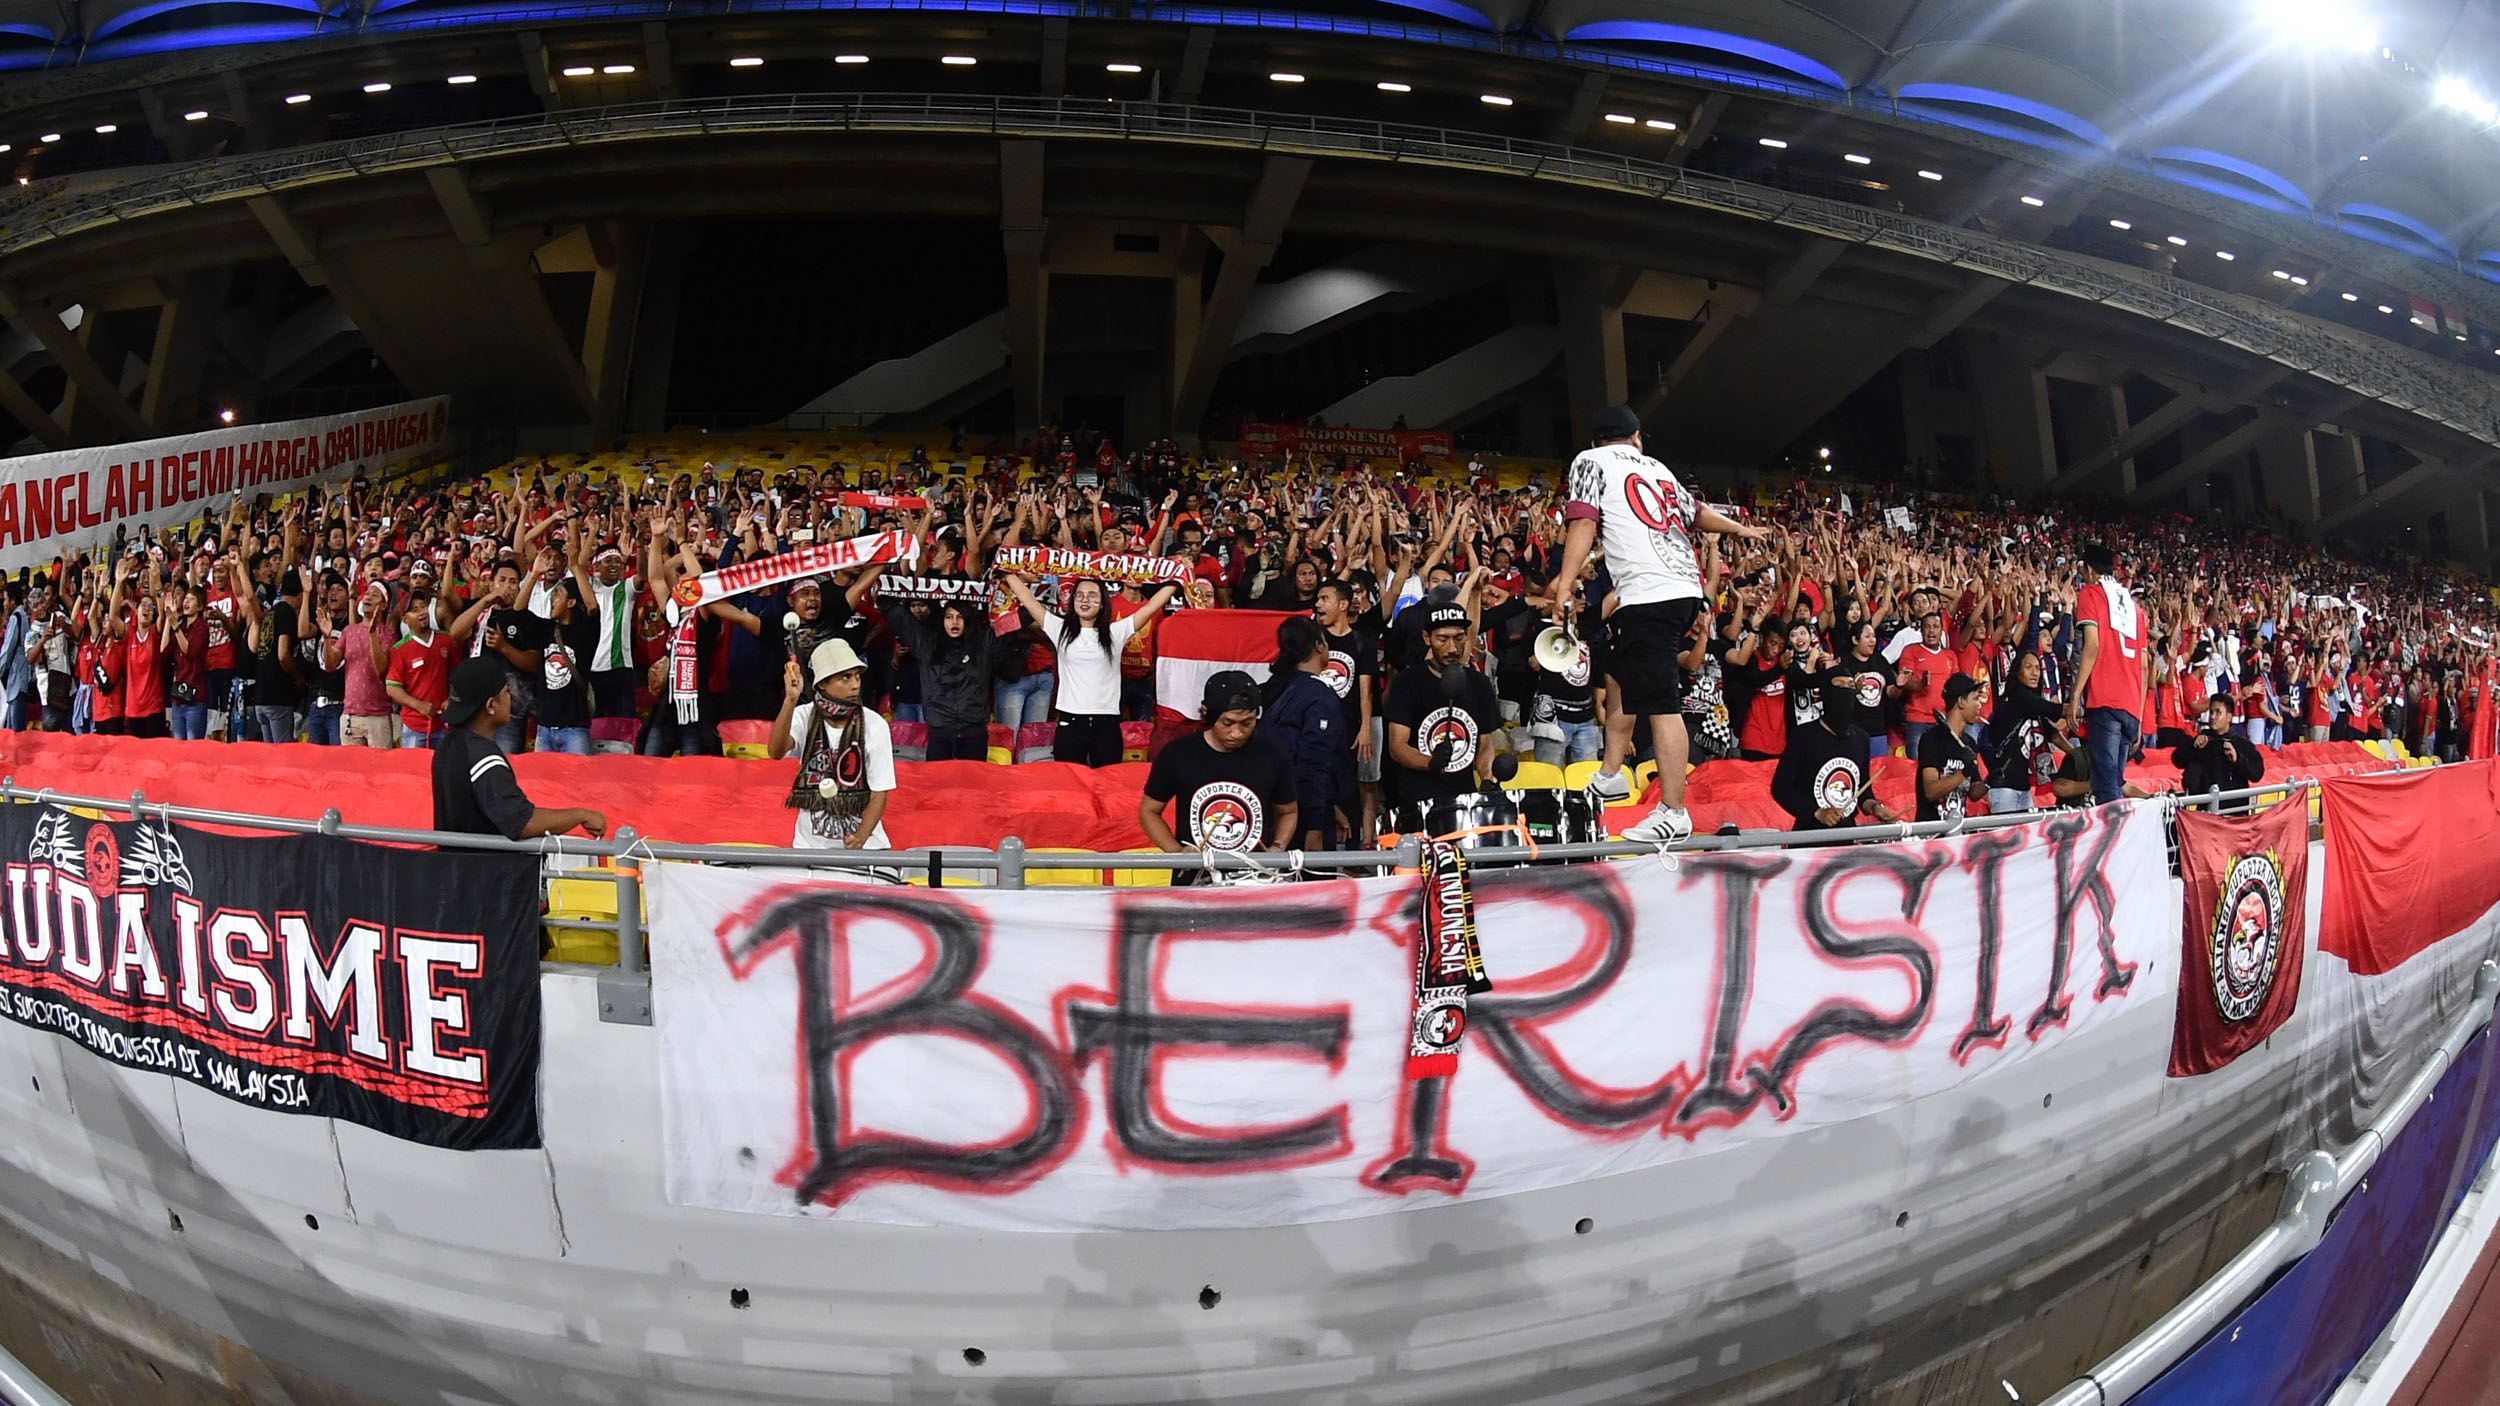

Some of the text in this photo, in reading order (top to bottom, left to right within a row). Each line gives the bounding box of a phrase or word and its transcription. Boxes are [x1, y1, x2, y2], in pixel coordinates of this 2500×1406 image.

[161, 446, 234, 508] DEMI
[239, 436, 320, 488] HARGA
[363, 411, 429, 458] BANGSA
[1300, 427, 1398, 444] INDONESIA
[717, 539, 860, 592] INDONESIA
[1048, 549, 1092, 570] FOR
[1431, 609, 1465, 622] FUCK
[1428, 709, 1464, 723] SUPOER
[1190, 784, 1263, 840] ALIANSI SUPORTER INDONESIA
[1440, 873, 1467, 976] INDONESIA
[2217, 901, 2232, 982] ALIANSI
[2229, 858, 2268, 899] SUPORTER
[0, 862, 489, 1091] UDAISME
[716, 804, 2137, 1212] BERISIK
[15, 992, 82, 1038] SUPORTER
[81, 1018, 177, 1069] INDONESIA
[179, 1044, 203, 1079] DI
[207, 1057, 311, 1107] MALAYSIA
